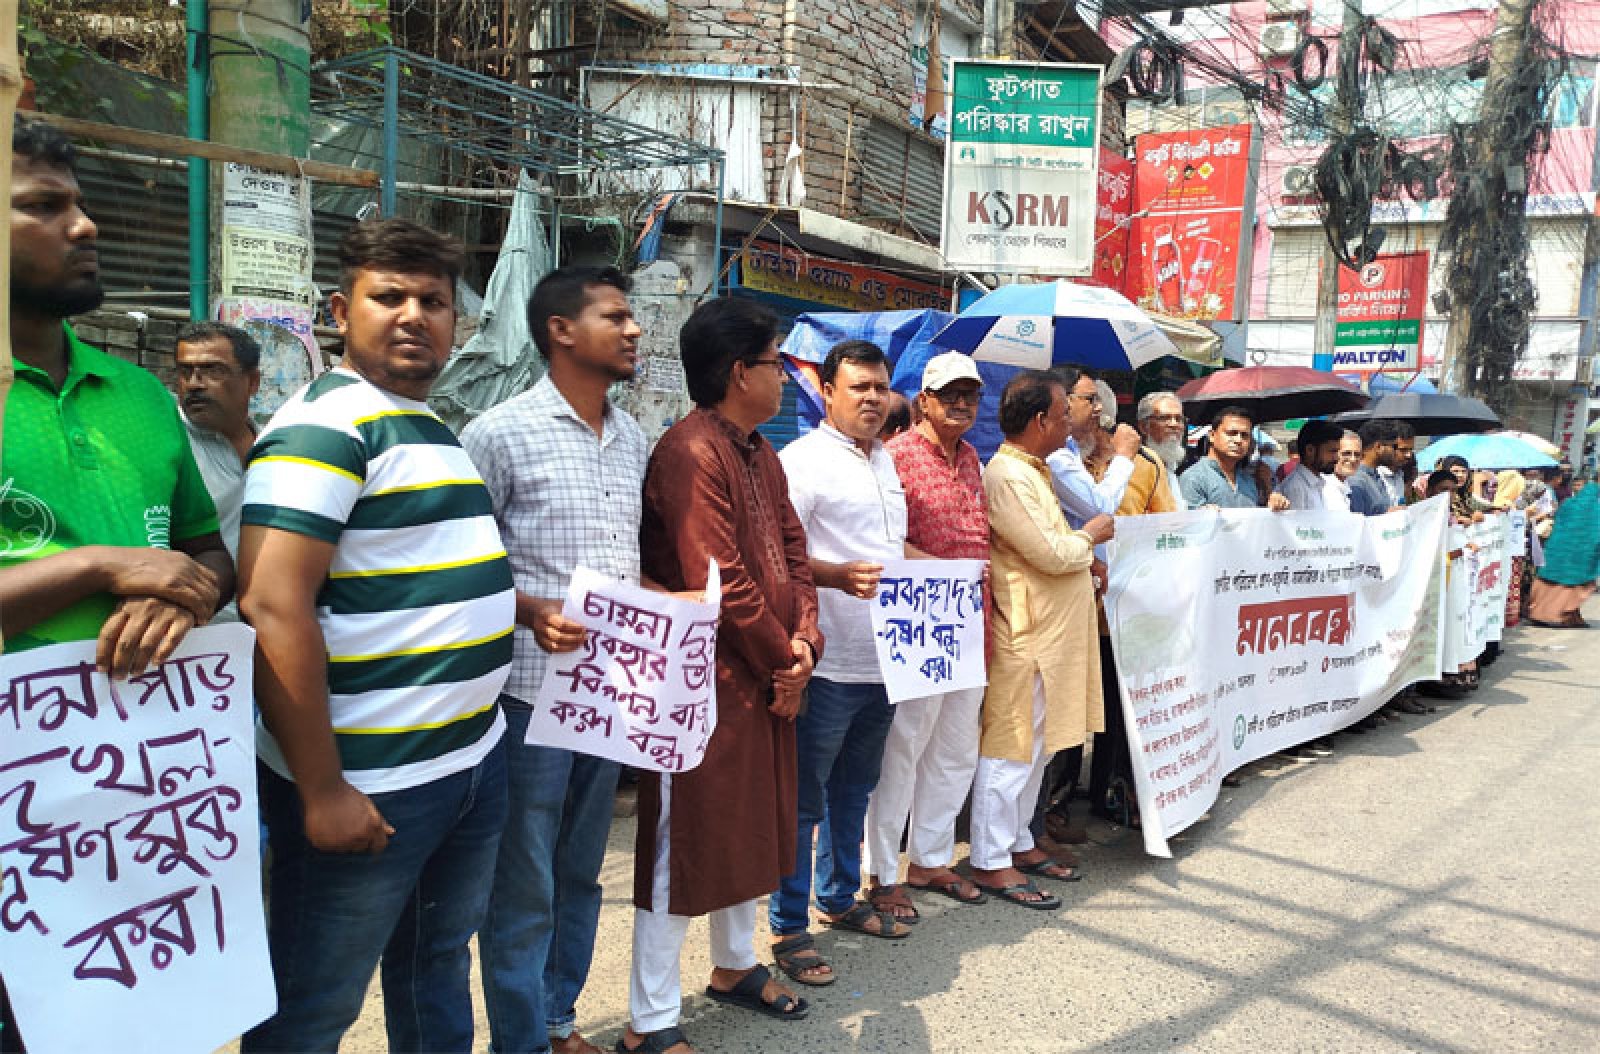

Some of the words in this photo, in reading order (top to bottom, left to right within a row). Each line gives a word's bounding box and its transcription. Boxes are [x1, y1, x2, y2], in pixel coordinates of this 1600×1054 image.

[985, 72, 1063, 104] ফুটপাত
[1037, 113, 1092, 142] রাখুন
[967, 189, 1070, 231] KSRM
[1333, 349, 1407, 364] WALTON
[583, 591, 673, 650] চায়না
